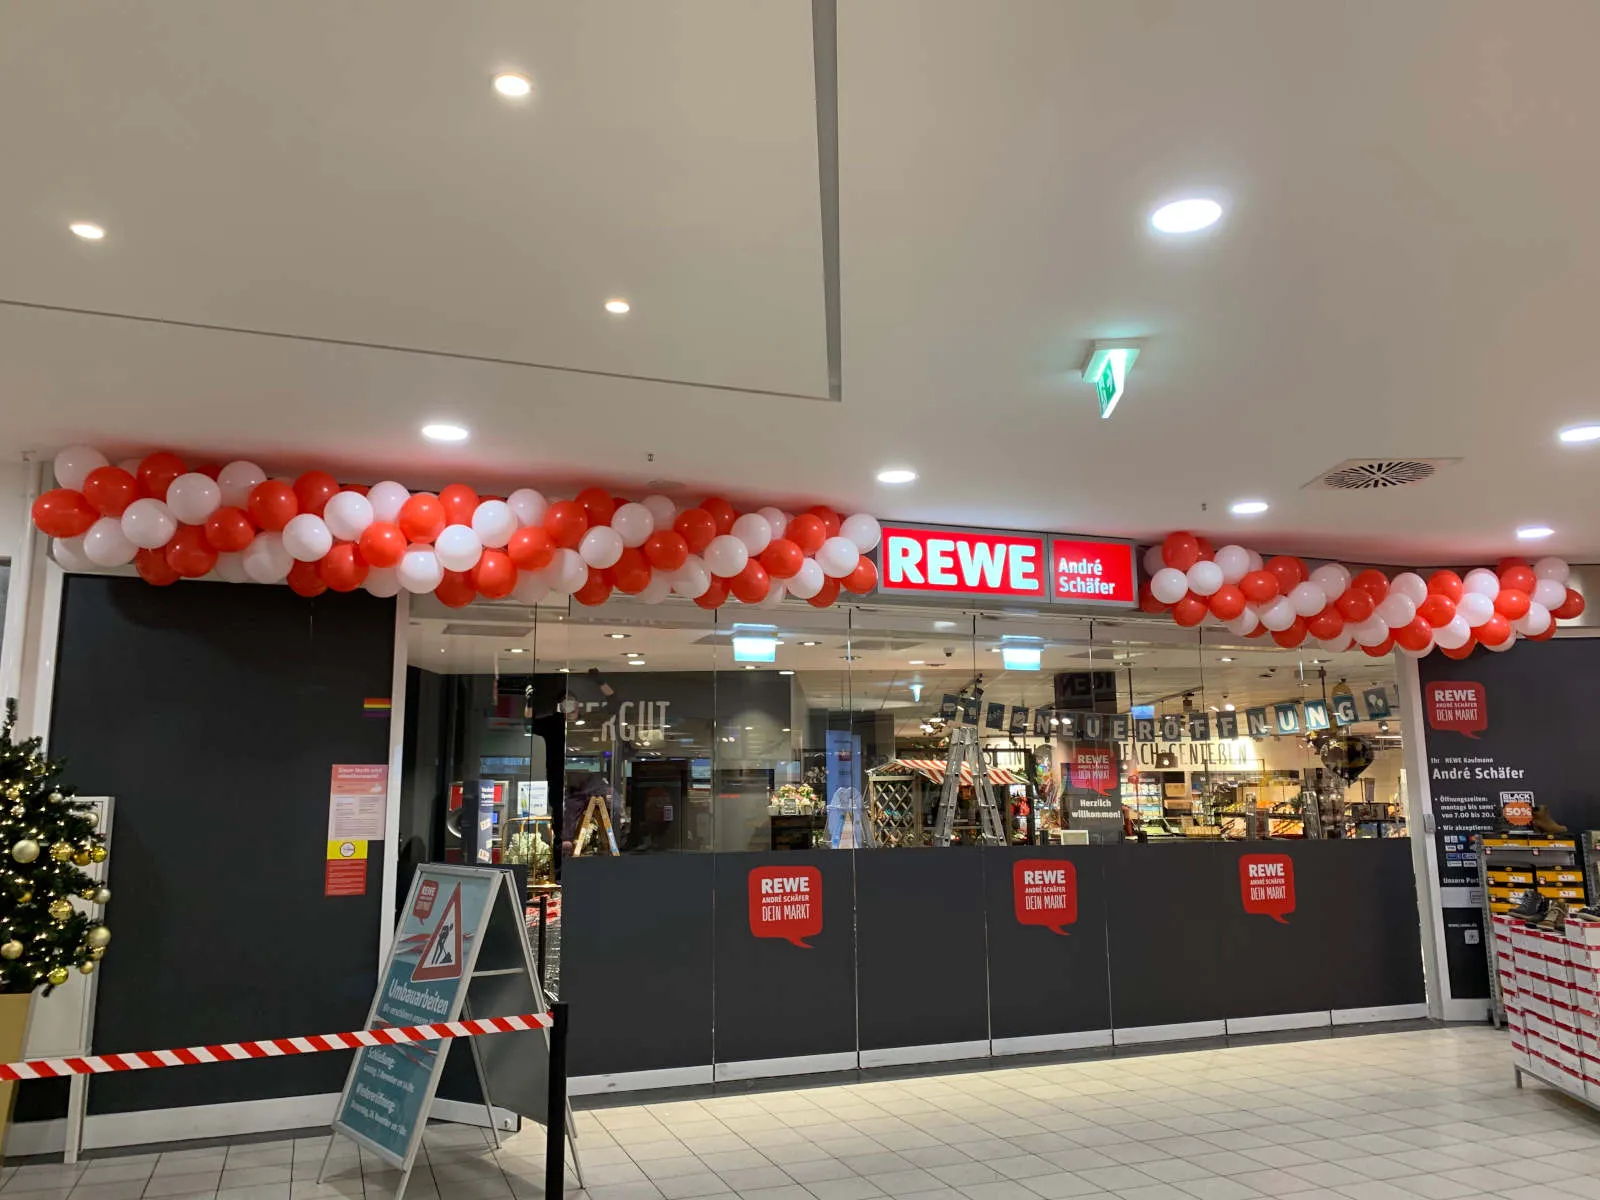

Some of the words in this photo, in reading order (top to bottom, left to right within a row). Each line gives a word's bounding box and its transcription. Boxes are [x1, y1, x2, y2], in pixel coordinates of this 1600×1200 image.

[888, 536, 1039, 590] REWE
[1058, 558, 1103, 575] André
[1059, 576, 1115, 595] Schäfer
[1434, 689, 1477, 702] REWE
[1436, 709, 1453, 721] DEIN
[1455, 708, 1478, 721] MARKT
[1078, 754, 1109, 764] REWE
[1463, 756, 1494, 764] Kaufmann
[1432, 767, 1471, 779] André
[1475, 766, 1525, 779] Schäfer
[1080, 799, 1112, 807] Herzlich
[1071, 809, 1121, 818] willkommen!
[1505, 807, 1533, 817] 50%
[1024, 869, 1066, 885] REWE
[1248, 863, 1285, 877] REWE
[761, 877, 810, 894] REWE
[761, 895, 782, 904] ANDRÉ
[783, 894, 810, 903] SCHÄFER
[1250, 887, 1265, 901] DEIN
[1267, 886, 1286, 900] MARKT
[1025, 895, 1042, 910] DEIN
[1044, 894, 1067, 909] MARKT
[762, 905, 782, 922] DEIN
[783, 904, 810, 920] MARKT
[388, 978, 449, 1015] Umbauarbeiten
